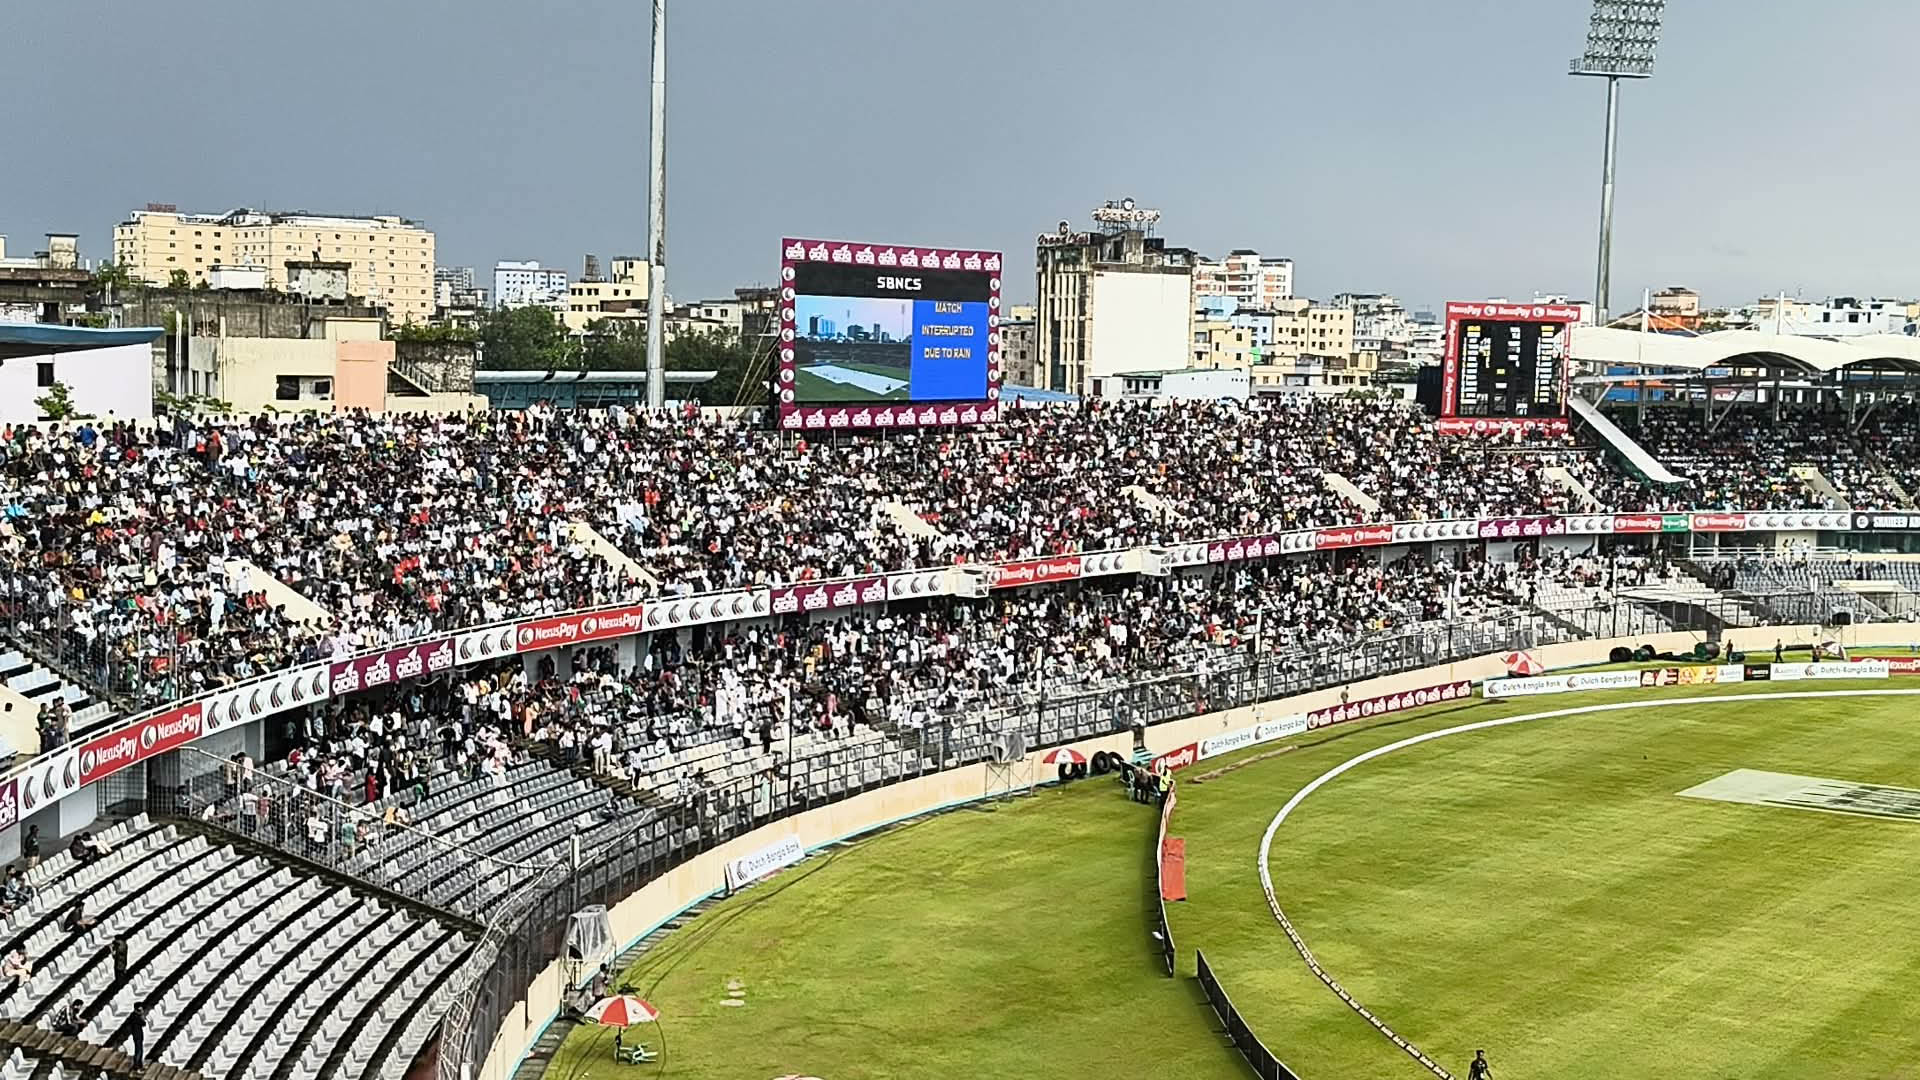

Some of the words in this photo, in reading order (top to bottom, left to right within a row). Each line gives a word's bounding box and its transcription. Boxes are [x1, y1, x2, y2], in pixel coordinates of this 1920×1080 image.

[877, 276, 922, 290] SBNCS
[935, 301, 962, 313] MATCH
[922, 325, 974, 336] INTERRUPTED
[924, 347, 940, 358] DUE
[941, 347, 953, 358] TO
[953, 347, 971, 359] RAIN
[598, 613, 641, 630] NexusPay
[535, 622, 579, 640] NexusPay
[157, 713, 201, 741] NexusPay
[96, 736, 137, 766] NexusPay
